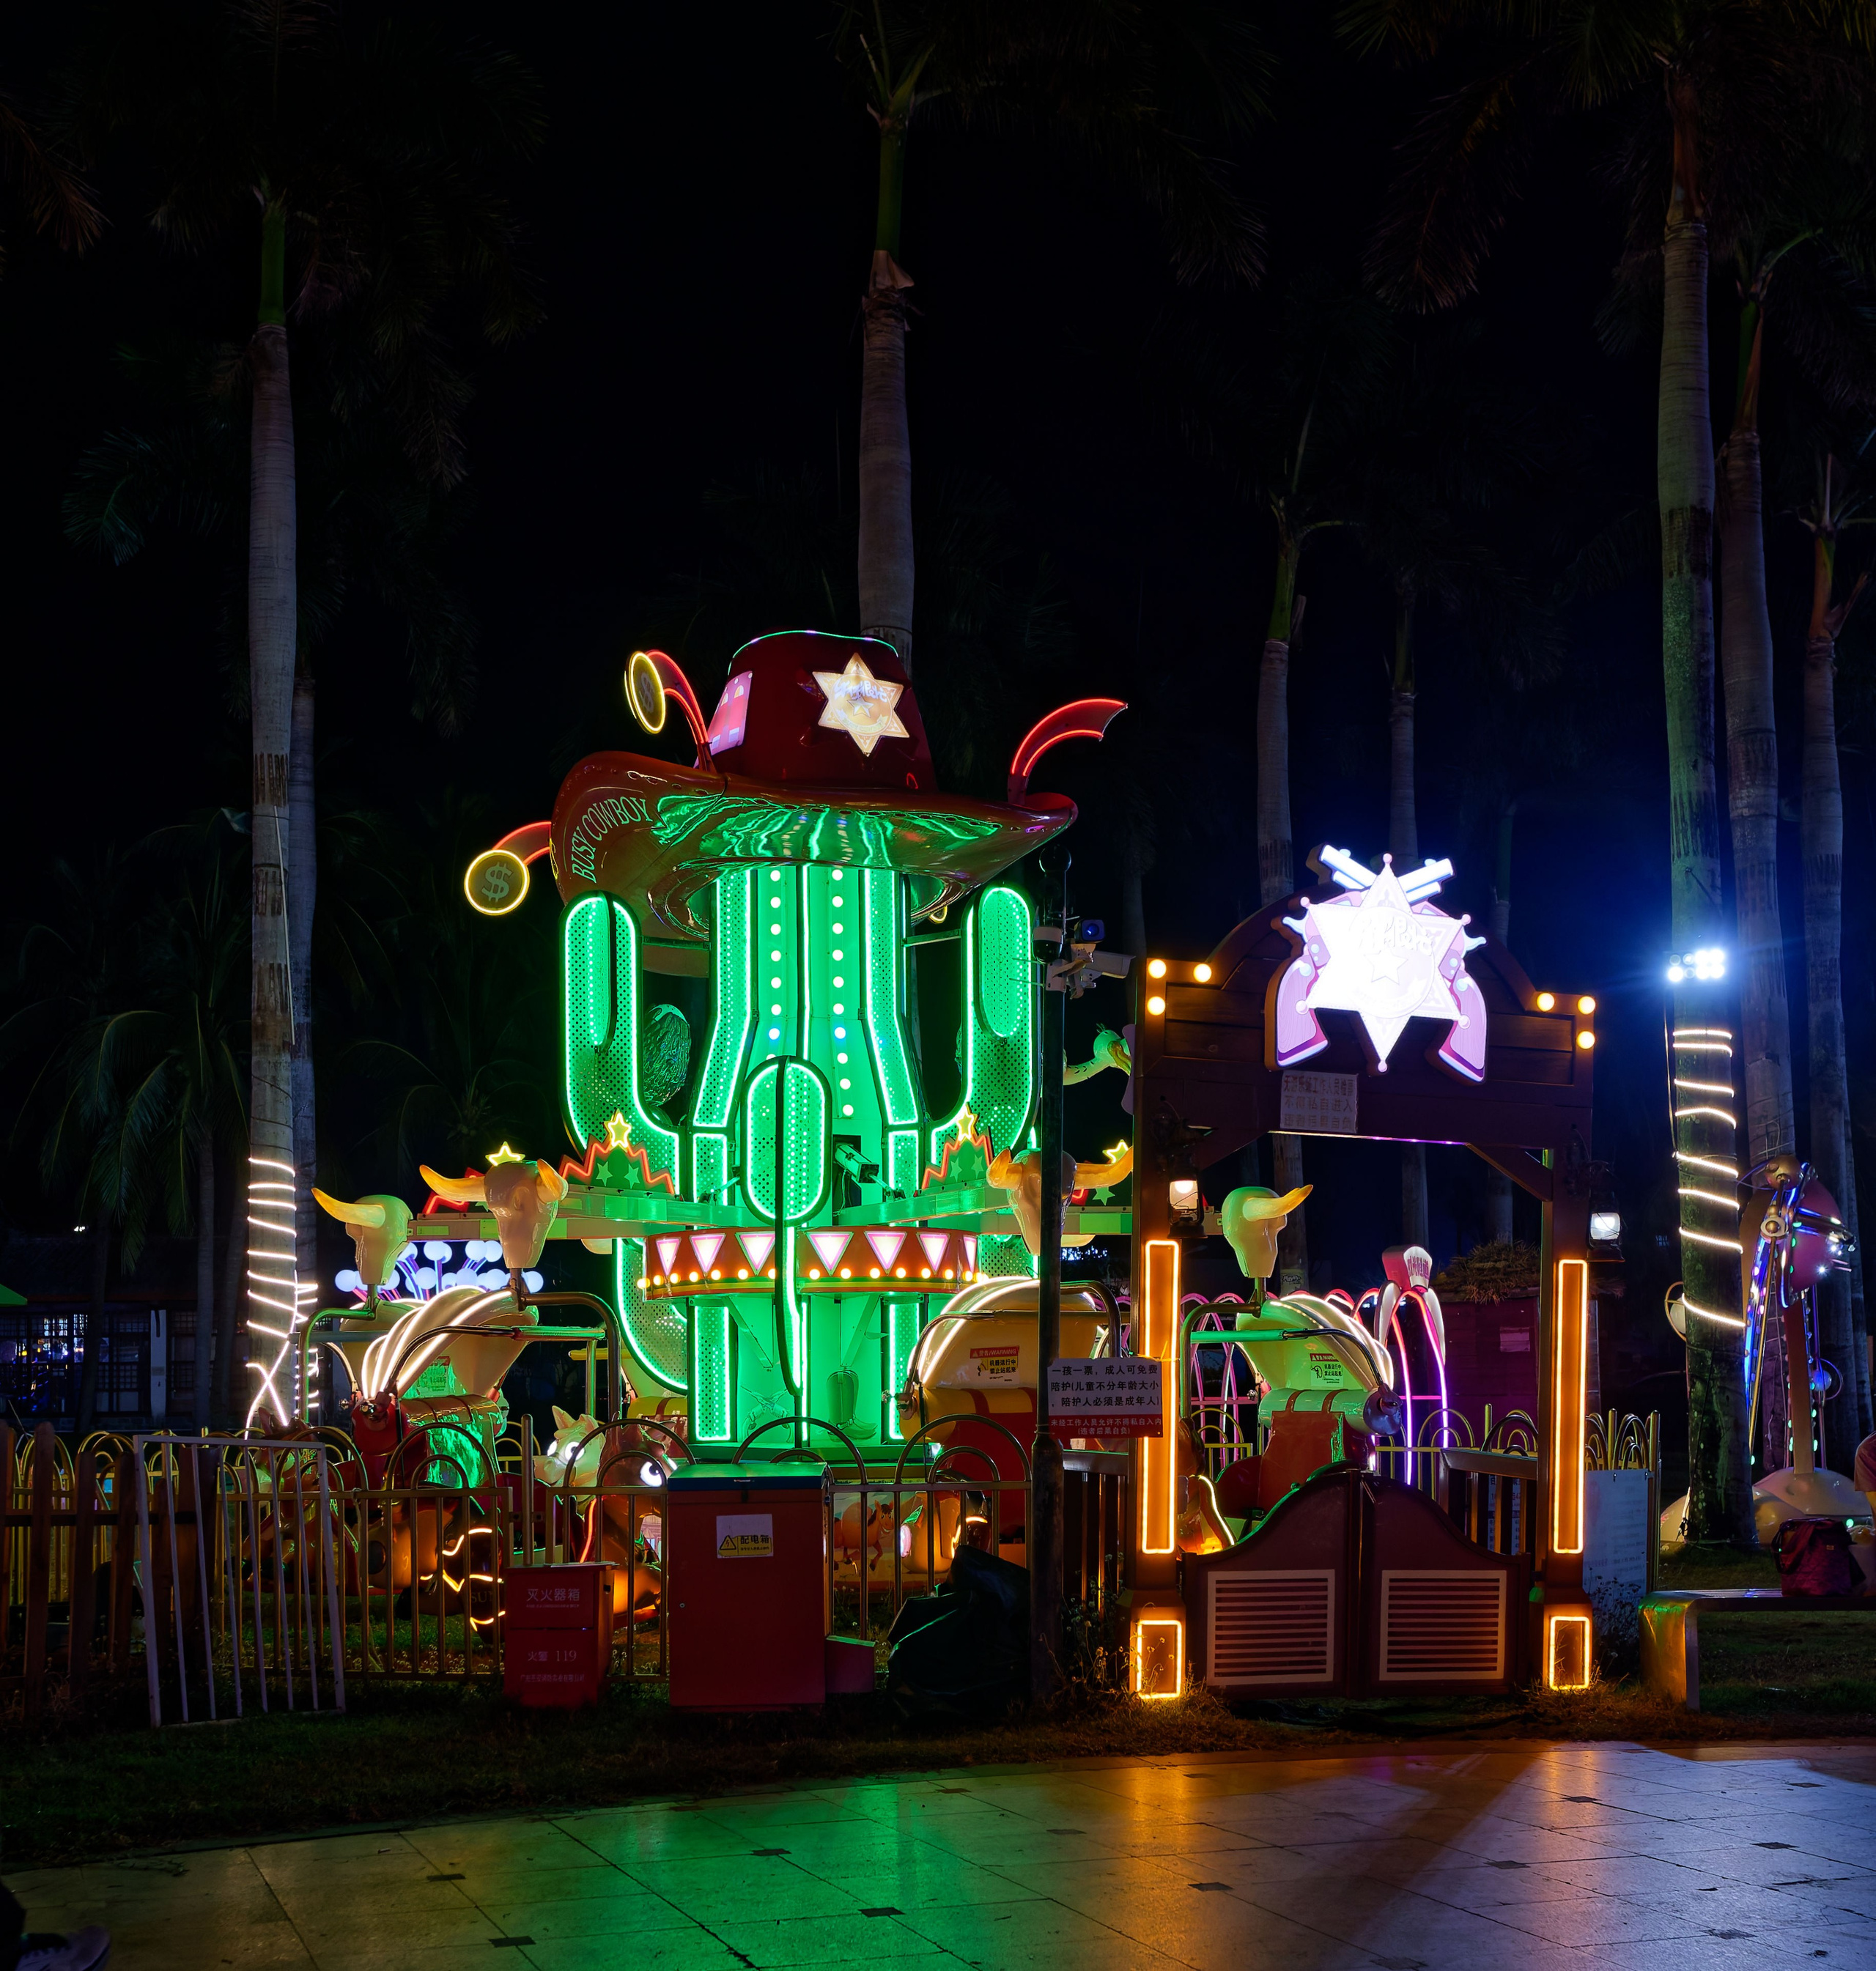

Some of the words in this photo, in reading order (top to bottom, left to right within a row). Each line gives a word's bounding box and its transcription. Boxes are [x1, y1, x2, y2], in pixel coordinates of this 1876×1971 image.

[582, 796, 653, 841] COWBOY
[572, 826, 597, 884] BUSY
[1051, 1418, 1162, 1427] 未经工作人员允许不得私自入内
[740, 1535, 769, 1545] 配电箱
[526, 1588, 580, 1602] 灭火器箱
[555, 1650, 577, 1662] 119
